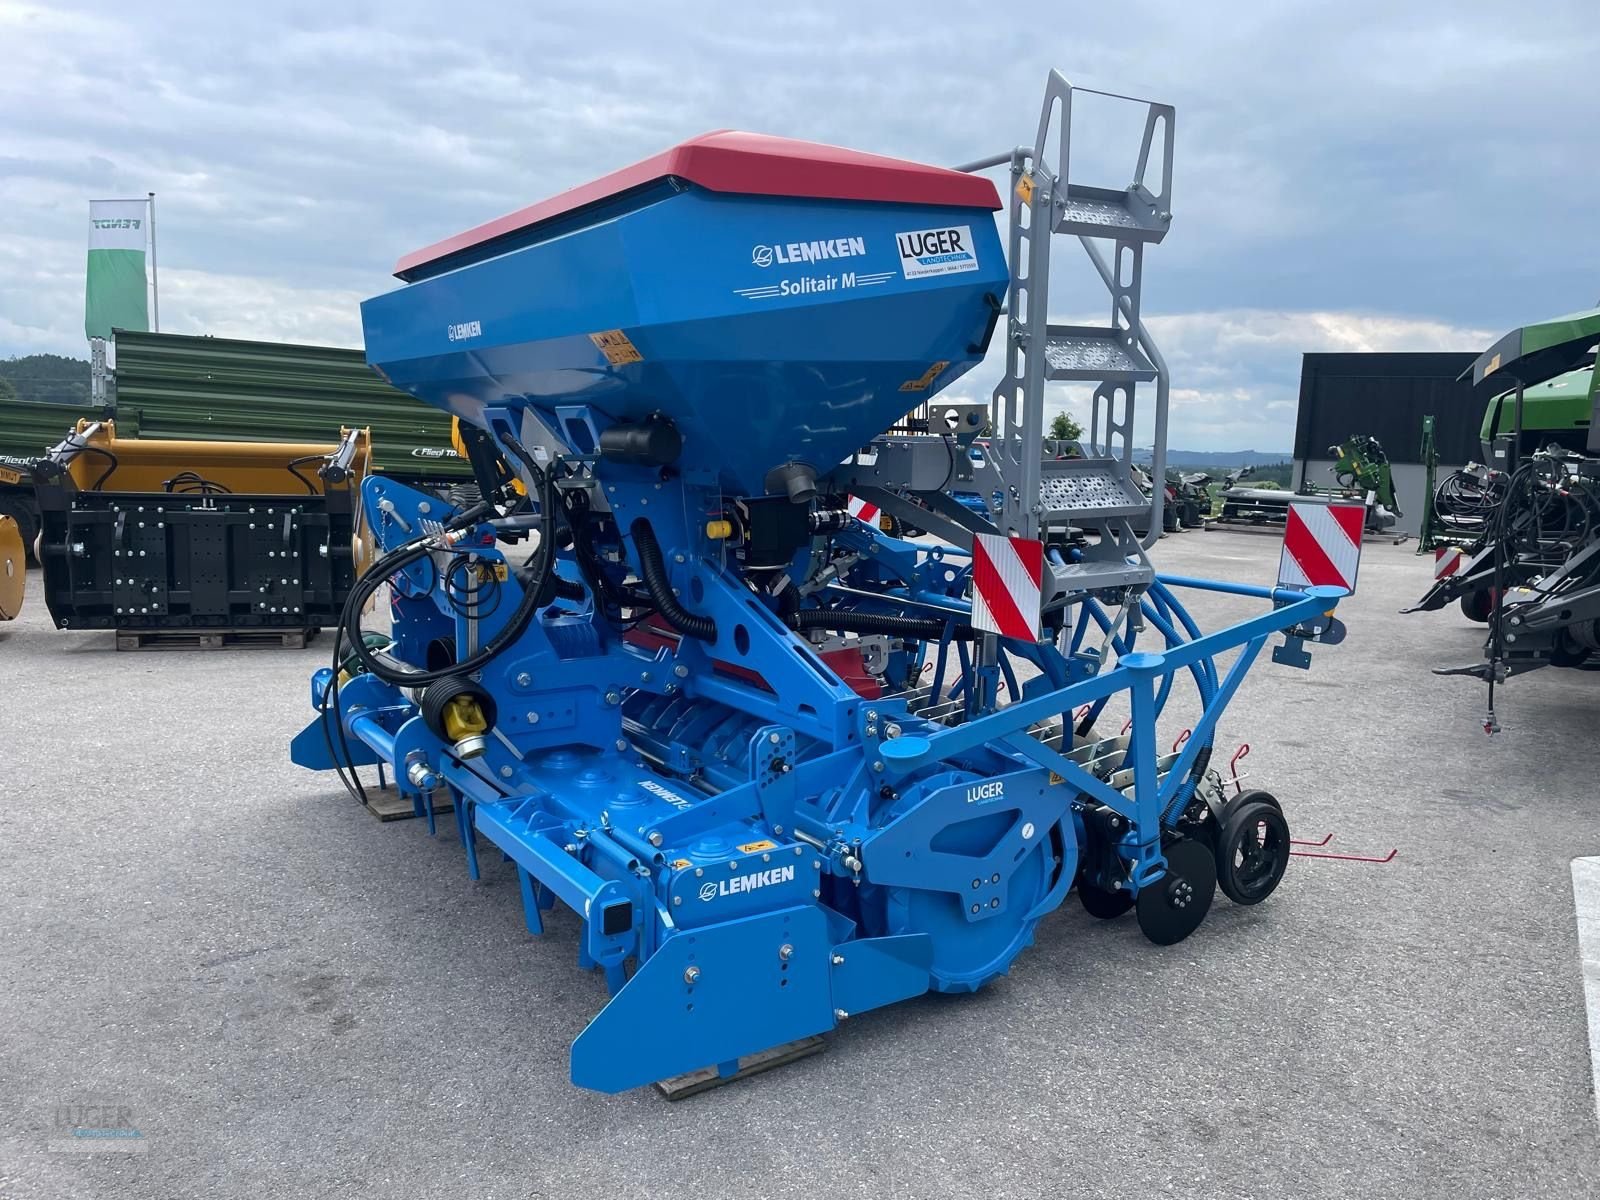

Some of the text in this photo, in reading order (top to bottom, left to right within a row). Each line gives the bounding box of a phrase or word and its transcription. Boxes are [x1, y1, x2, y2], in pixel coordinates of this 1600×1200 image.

[774, 236, 866, 265] LEMKEN
[898, 229, 965, 259] LUGER
[921, 254, 967, 265] LANDTECHNIK
[780, 272, 857, 297] Solitair M
[453, 320, 482, 341] LEMKEN
[421, 448, 444, 458] Fliegl
[637, 780, 689, 807] LEMKEN
[967, 781, 1004, 803] LUGER
[719, 865, 795, 896] LEMKEN
